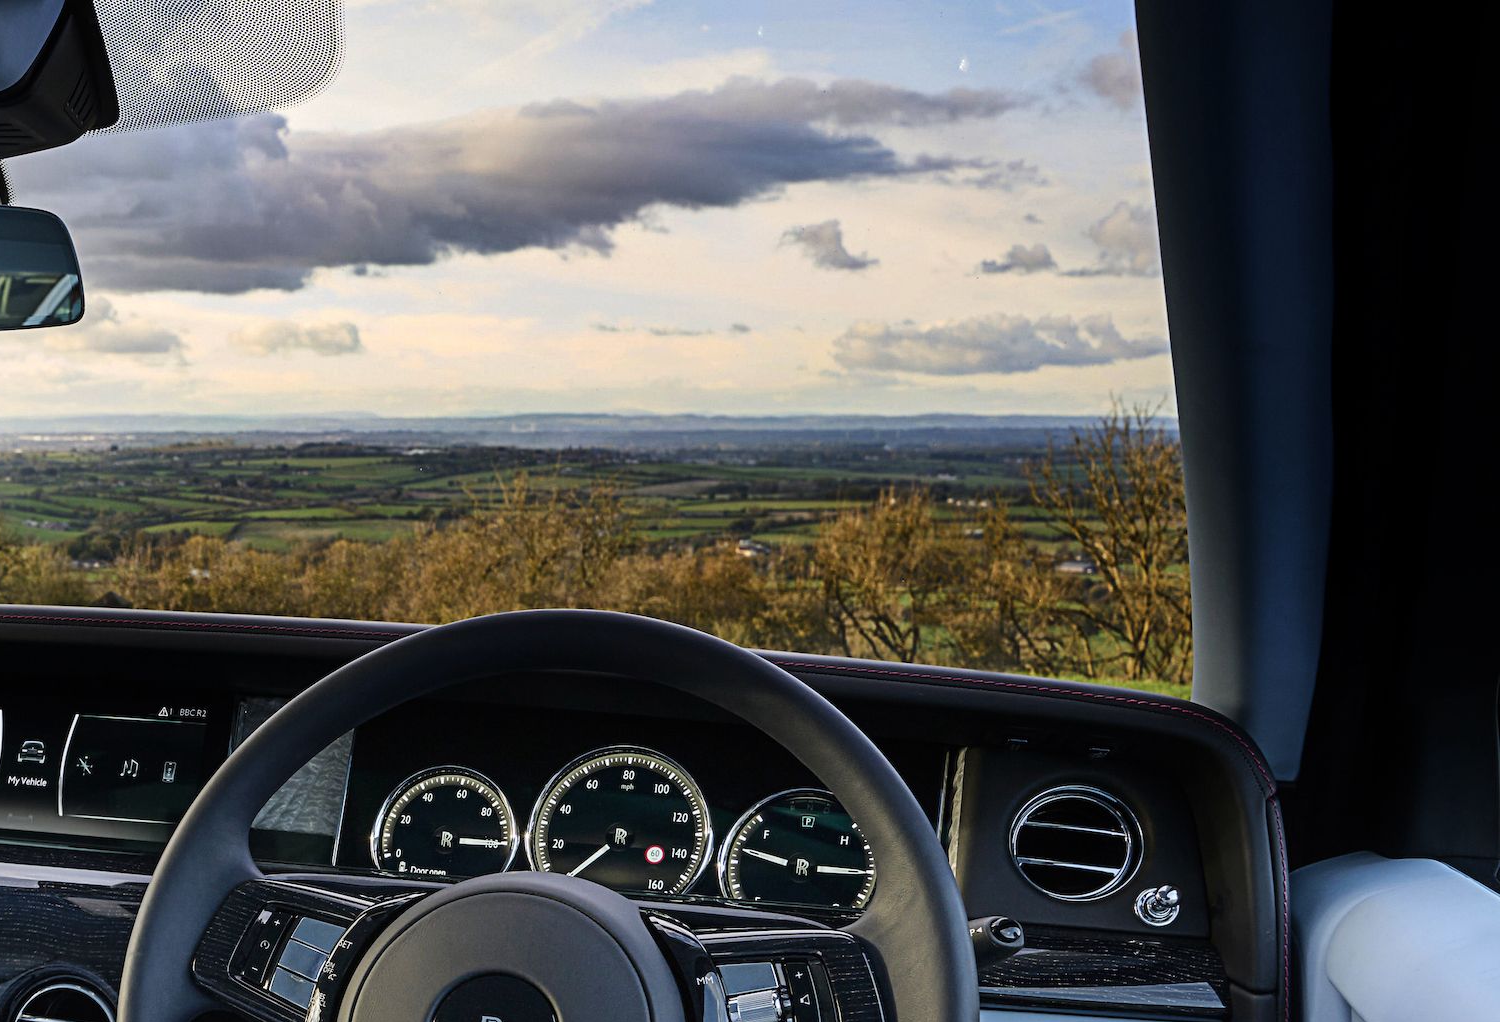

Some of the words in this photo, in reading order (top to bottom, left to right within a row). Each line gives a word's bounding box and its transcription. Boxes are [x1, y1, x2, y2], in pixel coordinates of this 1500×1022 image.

[180, 708, 196, 717] BBC
[622, 770, 635, 780] 80
[7, 775, 20, 787] My
[21, 776, 47, 788] Vehicle
[586, 779, 599, 790] 60
[620, 783, 634, 791] mph
[654, 783, 670, 795] 100
[422, 792, 433, 802] 40
[456, 789, 467, 799] 60
[480, 807, 492, 817] 80
[559, 804, 572, 815] 40
[400, 815, 411, 824] 20
[672, 812, 689, 823] 120
[763, 830, 770, 839] F
[551, 839, 565, 849] 20
[839, 835, 849, 846] H
[395, 849, 402, 858] 0
[650, 850, 660, 858] 60
[671, 848, 688, 859] 140
[648, 879, 664, 890] 160
